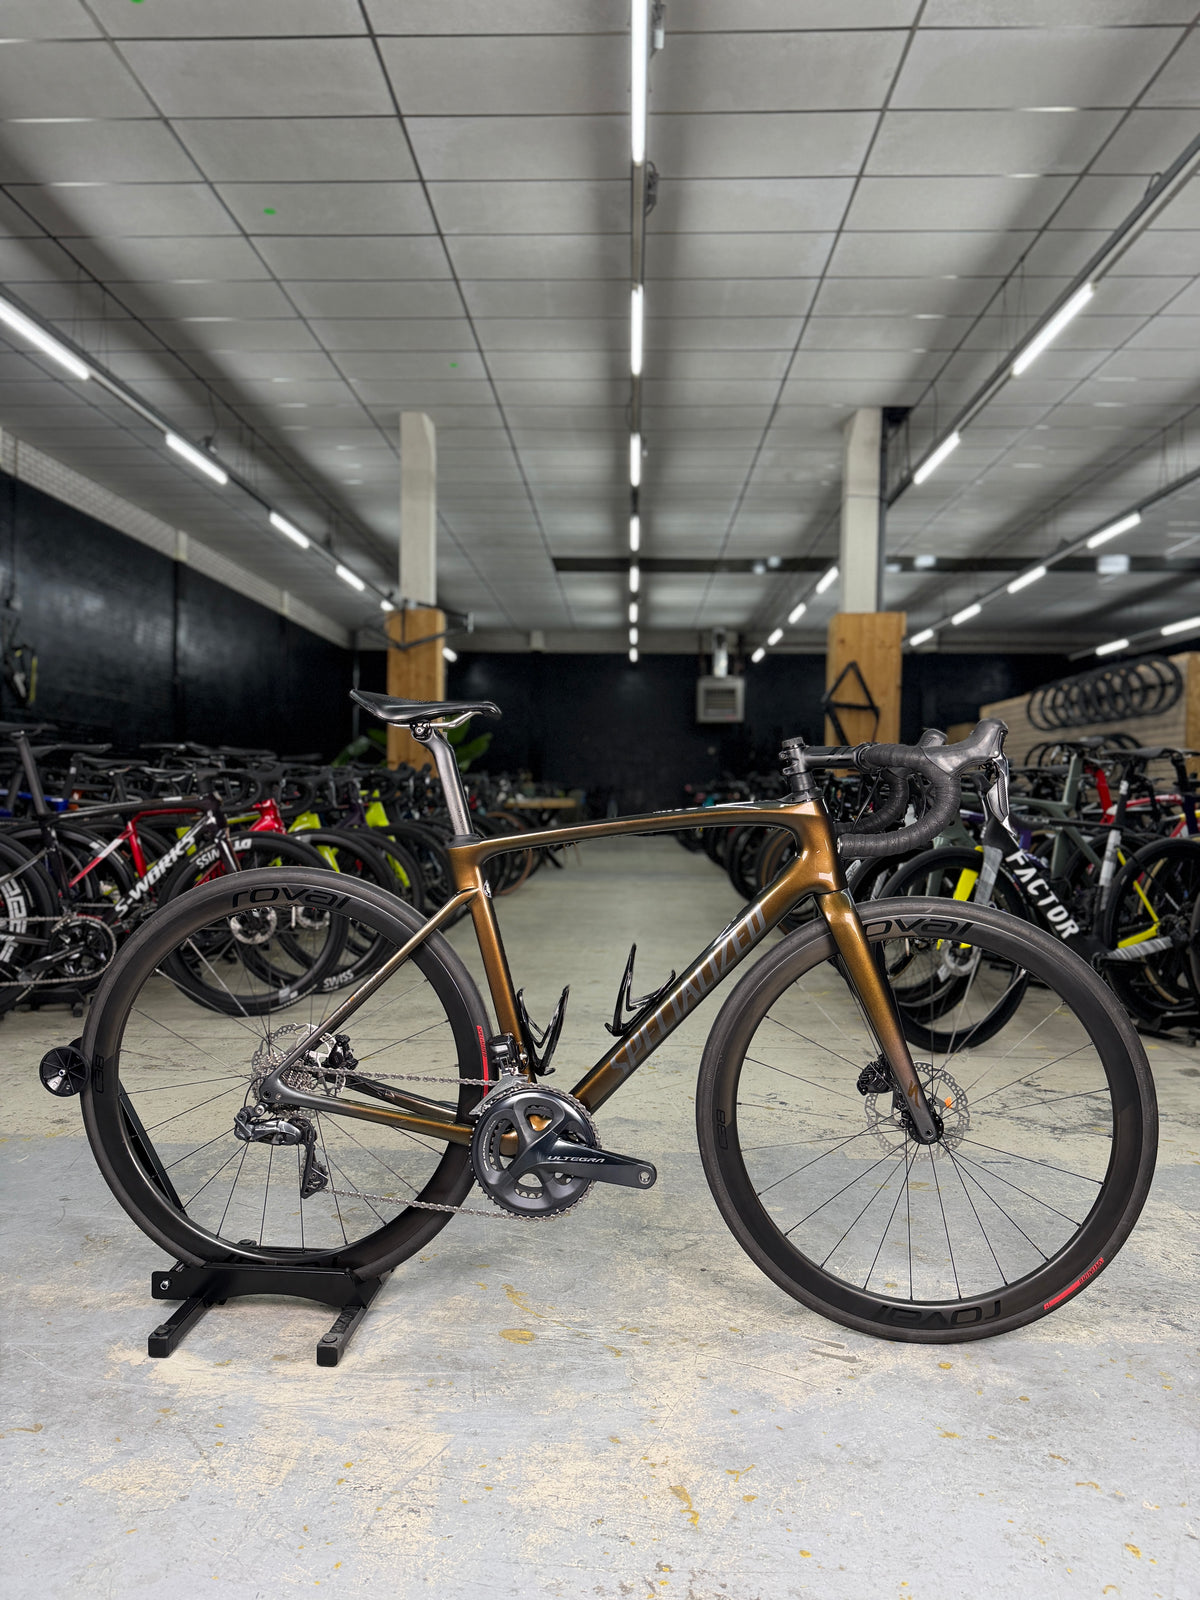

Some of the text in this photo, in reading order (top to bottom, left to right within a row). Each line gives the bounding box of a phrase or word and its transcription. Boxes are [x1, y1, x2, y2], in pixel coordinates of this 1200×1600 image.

[195, 848, 221, 870] WISS
[114, 834, 196, 919] S-WORKS
[232, 887, 352, 909] roval
[1004, 849, 1080, 940] FACTOR
[862, 918, 974, 938] oval
[322, 969, 355, 989] SWISS
[609, 902, 768, 1076] SPECIALIZED
[547, 1155, 606, 1163] ULTEGRA
[874, 1299, 1001, 1325] roval
